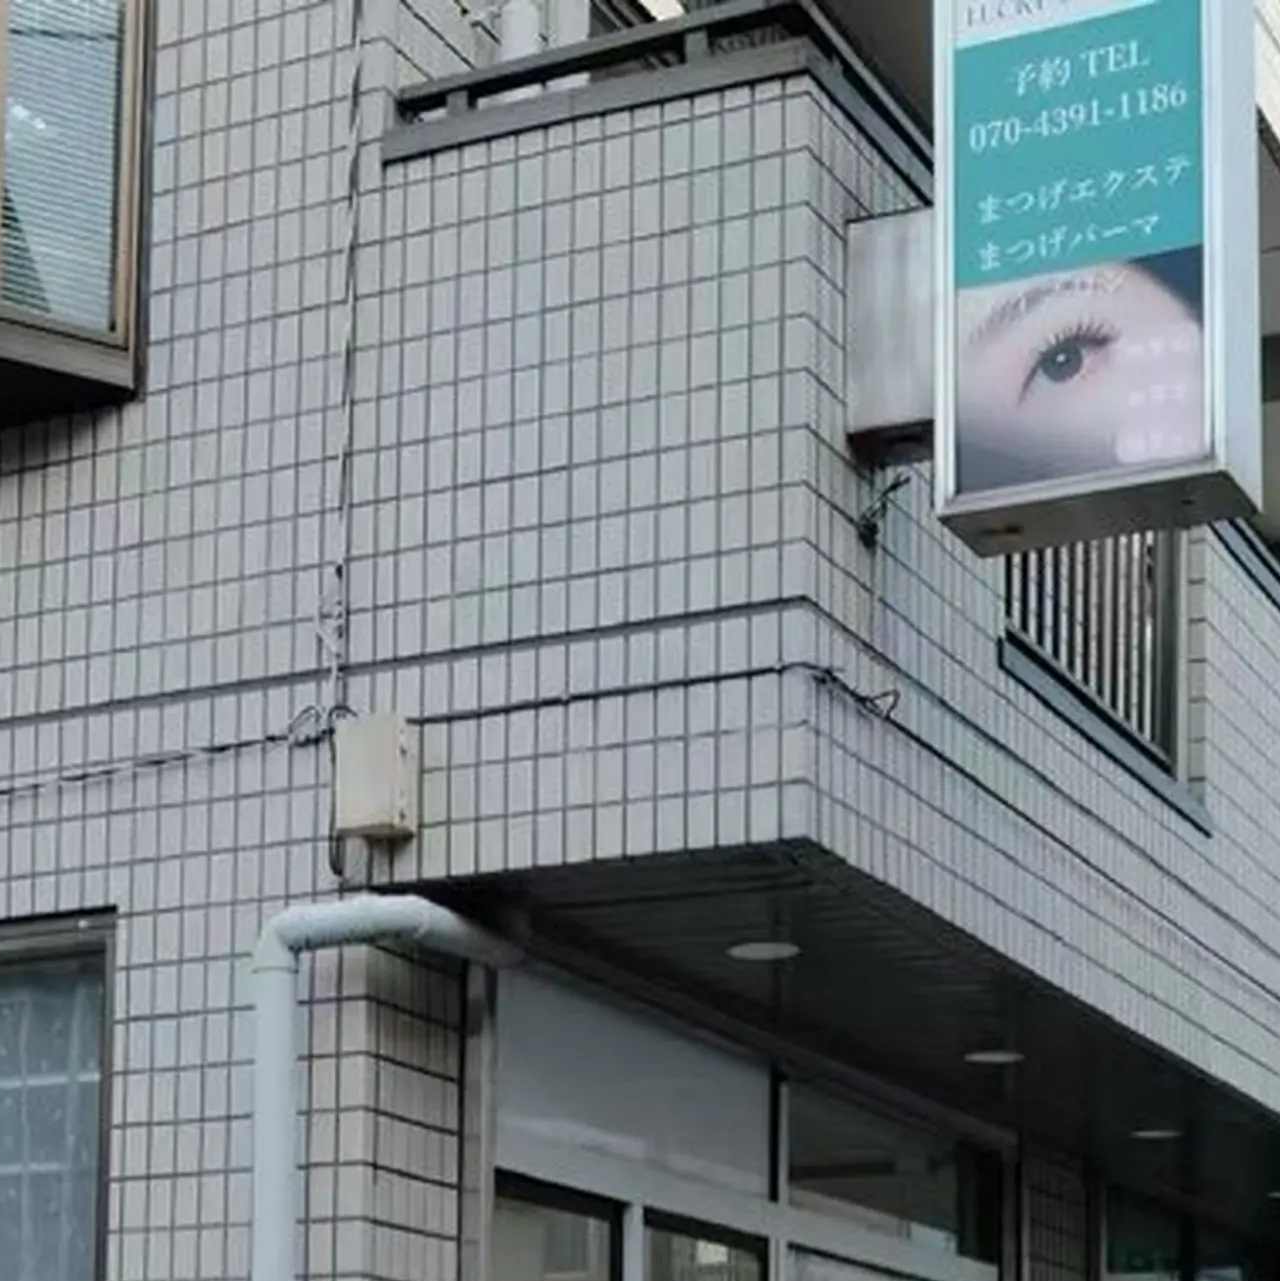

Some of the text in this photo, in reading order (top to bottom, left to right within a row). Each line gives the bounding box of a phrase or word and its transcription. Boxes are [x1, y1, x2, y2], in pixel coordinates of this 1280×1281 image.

[1008, 40, 1150, 96] 予約 TEL
[969, 80, 1188, 154] 070-4391-1186
[977, 154, 1191, 225] まつげエクステ
[978, 213, 1160, 272] まつげパーマ
